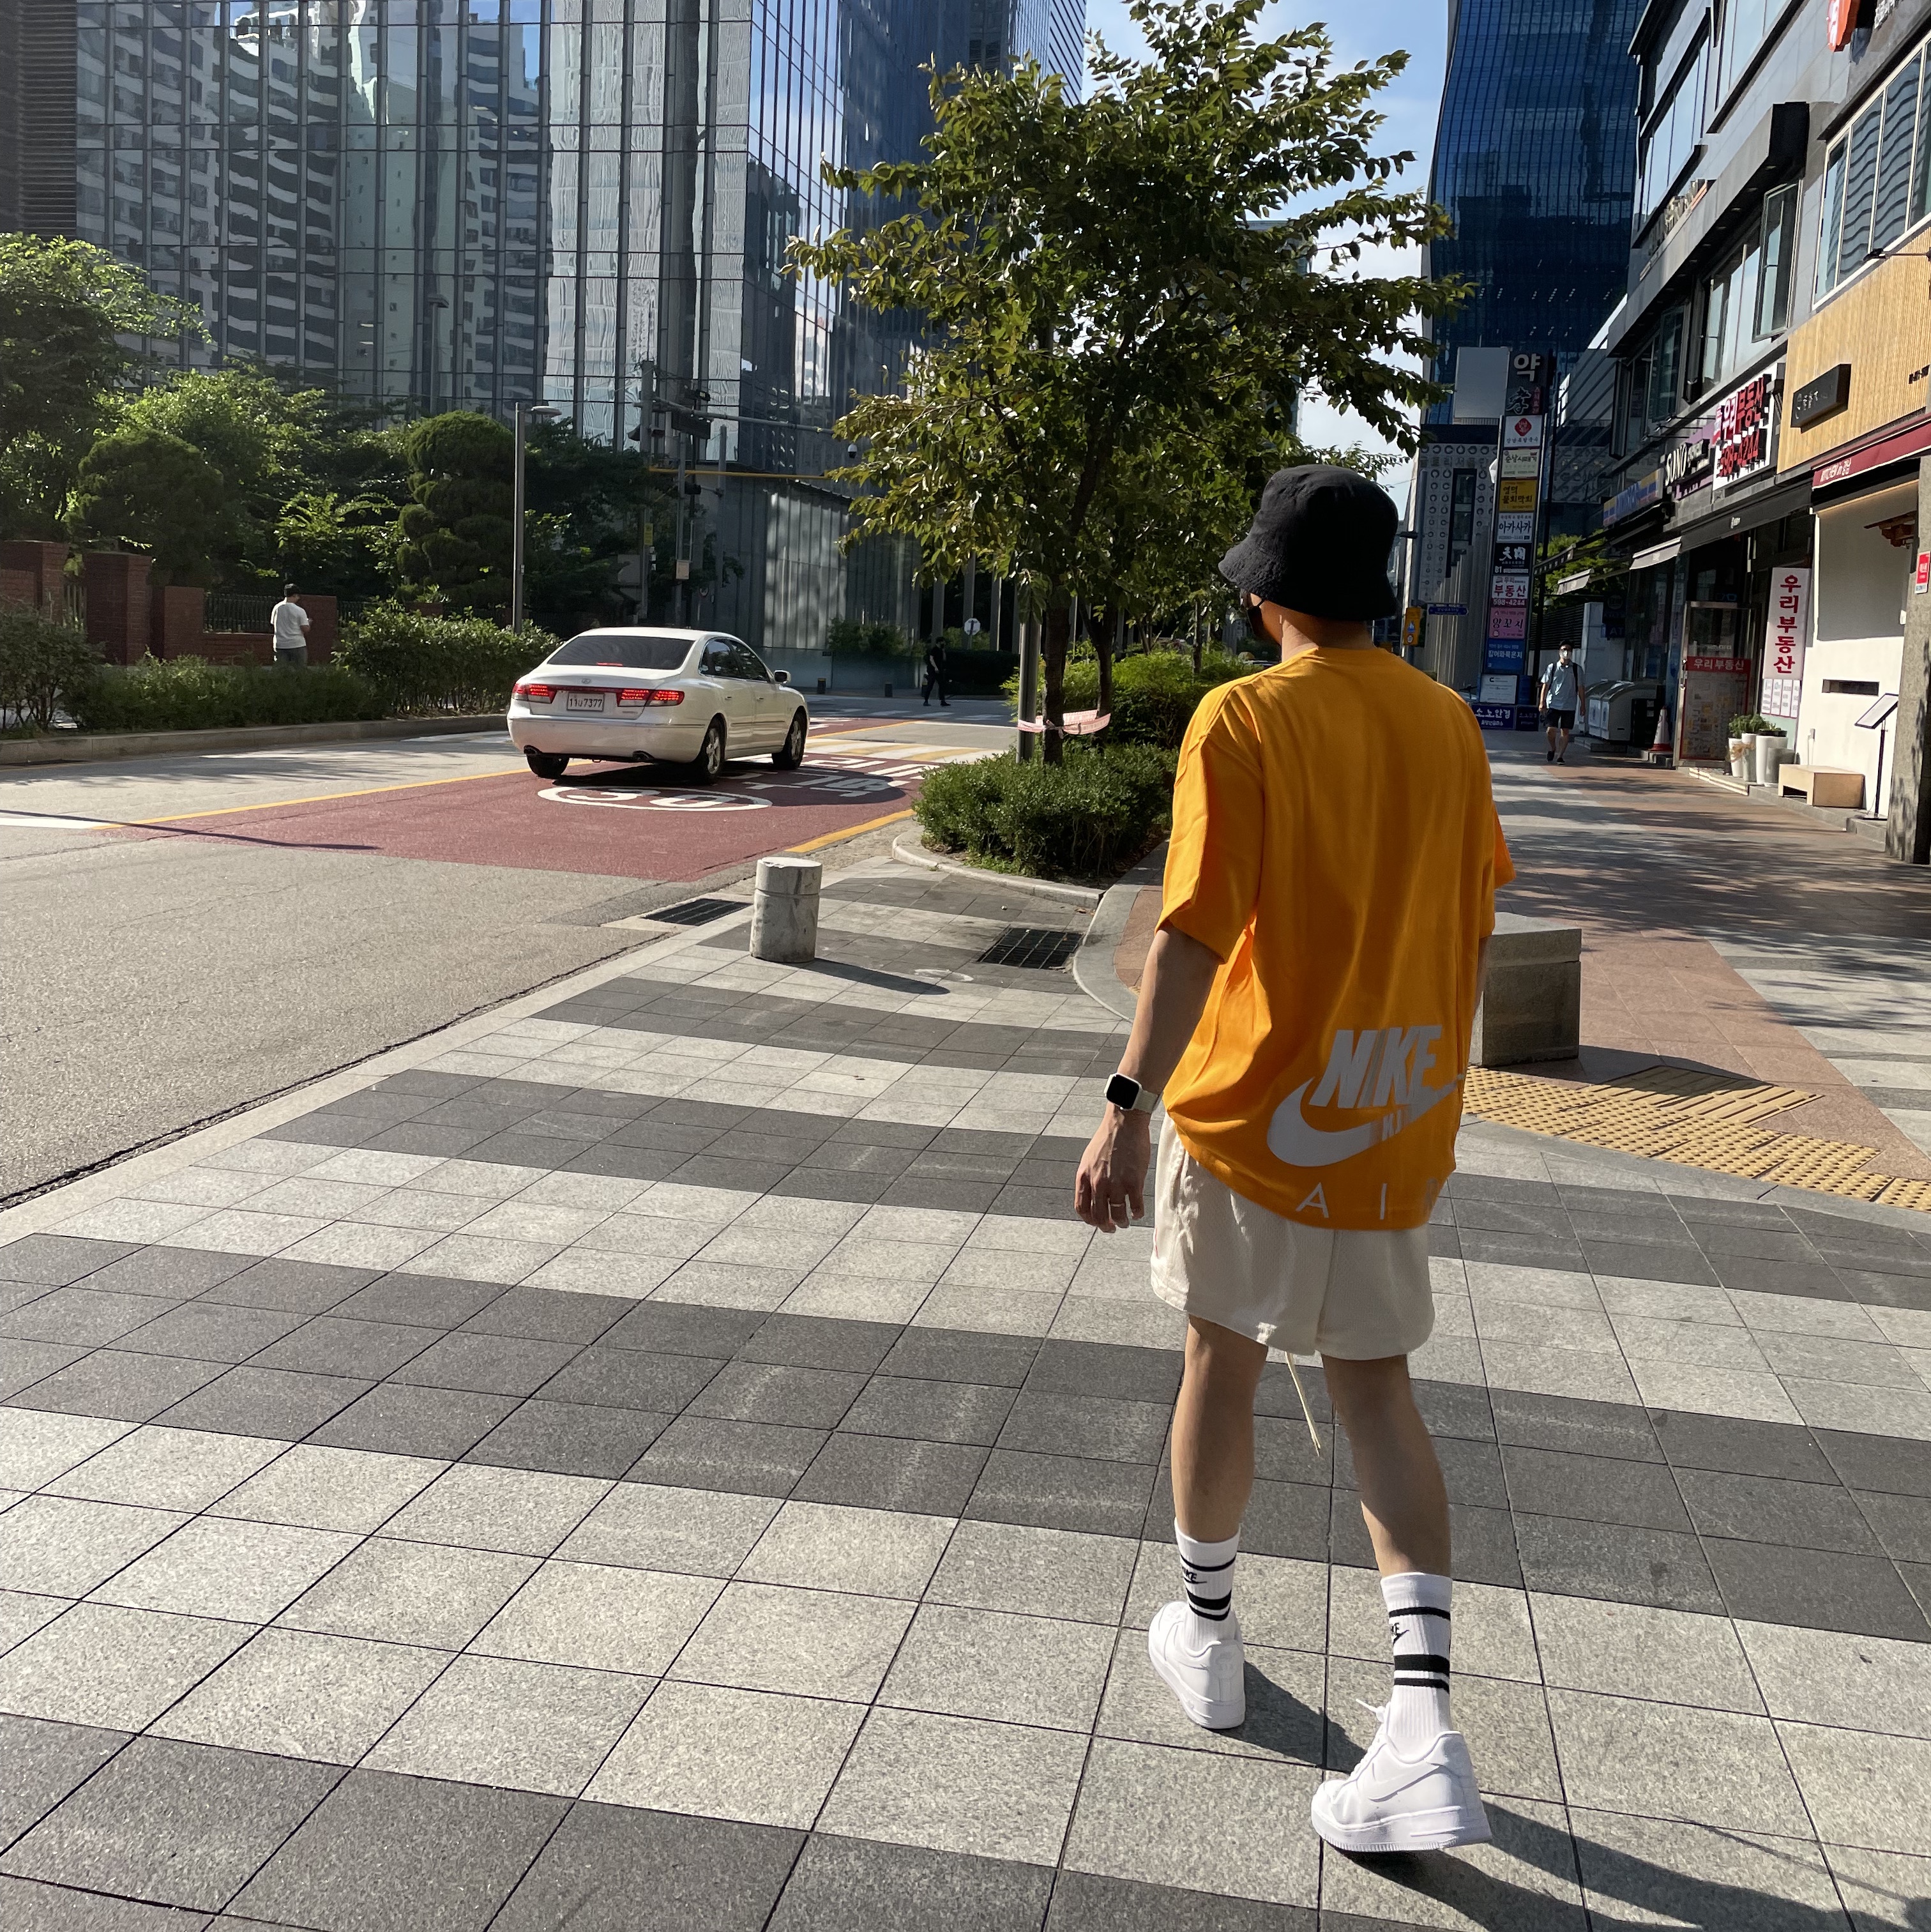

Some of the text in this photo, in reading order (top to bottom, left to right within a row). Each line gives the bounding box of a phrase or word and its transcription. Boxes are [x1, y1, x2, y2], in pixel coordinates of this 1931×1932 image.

[1513, 353, 1541, 382] 약
[1498, 521, 1531, 534] 아카사카
[1494, 584, 1527, 597] 부동산
[1773, 574, 1802, 674] 우리부동산
[1474, 707, 1511, 719] 소노안경
[1308, 1025, 1443, 1109] NIKE
